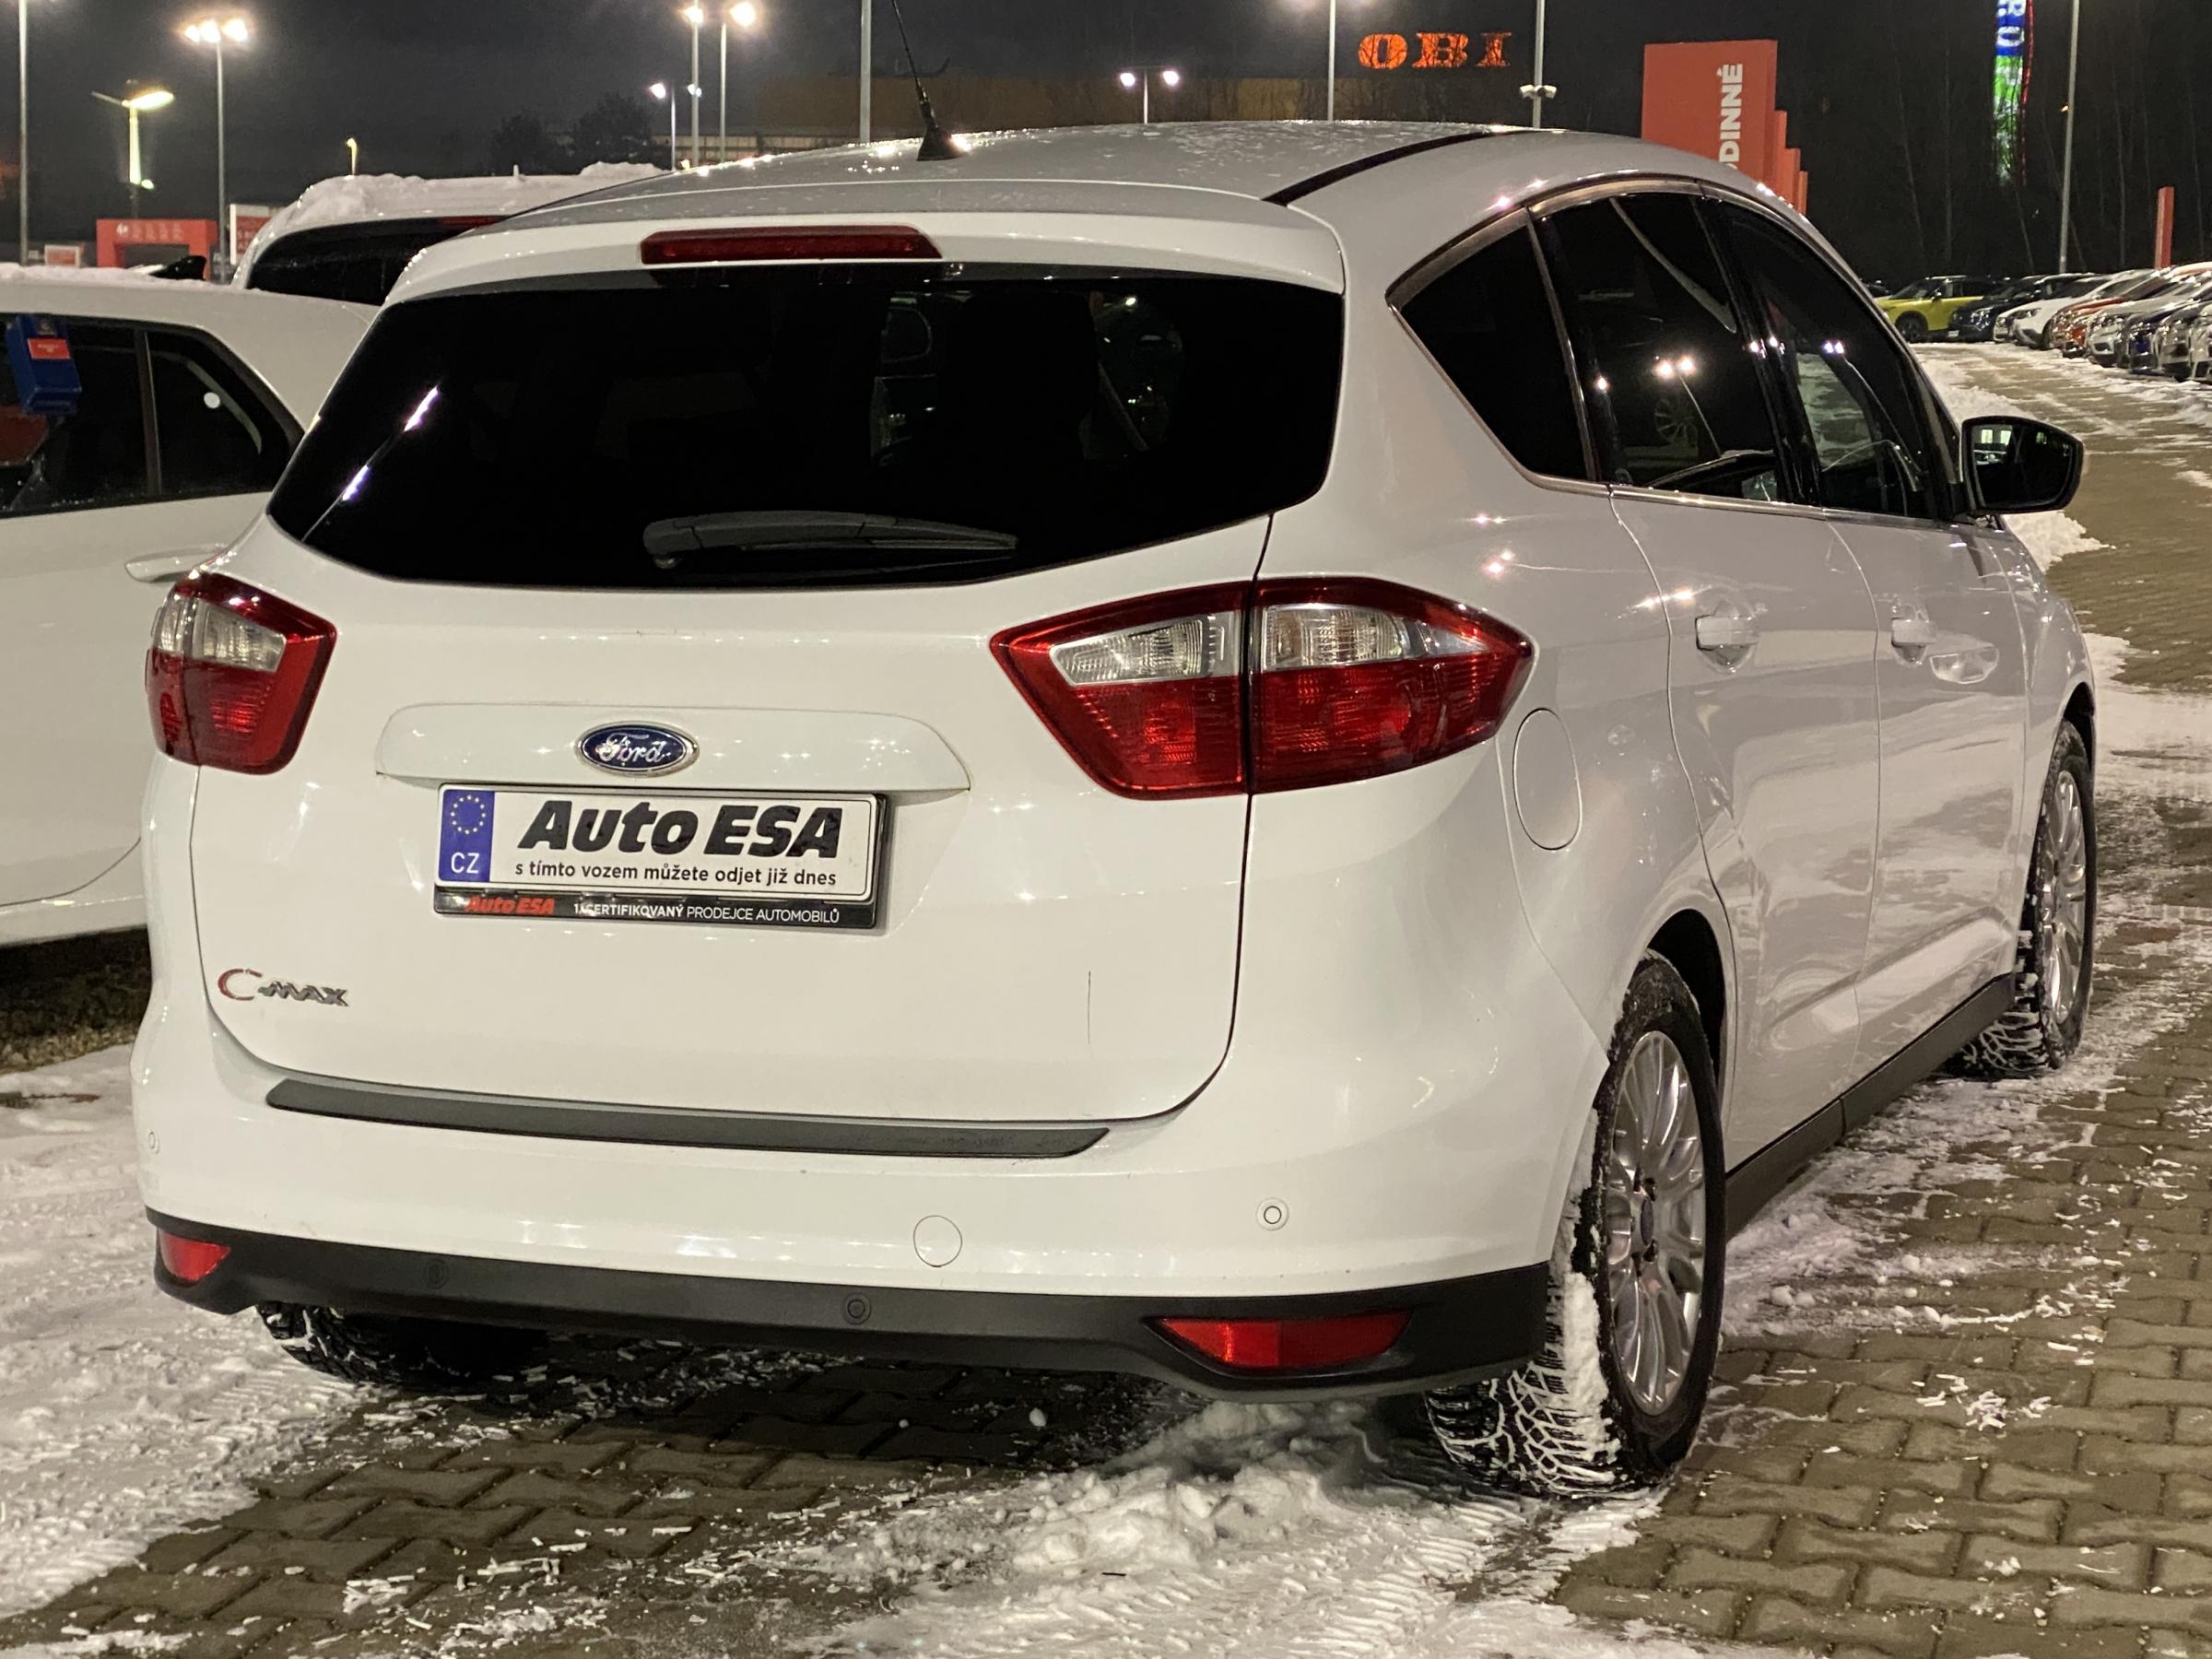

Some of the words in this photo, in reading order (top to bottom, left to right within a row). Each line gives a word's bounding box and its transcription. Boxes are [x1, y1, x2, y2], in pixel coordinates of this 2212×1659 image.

[1359, 32, 1512, 69] OBI
[1716, 64, 1744, 170] DINNÉ
[595, 732, 671, 762] Ford
[517, 800, 699, 855] Auto
[703, 805, 842, 858] ESA
[451, 852, 480, 874] CZ
[515, 864, 523, 875] s
[530, 860, 575, 877] tímto
[582, 865, 638, 879] vozem
[644, 864, 709, 881] můžete
[715, 867, 761, 885] odjet
[767, 868, 788, 886] již
[794, 869, 836, 885] dnes
[465, 896, 516, 913] Auto
[516, 897, 556, 915] ESA
[687, 906, 753, 921] PRODEJCE
[756, 908, 840, 923] AUTOMOBILŮ
